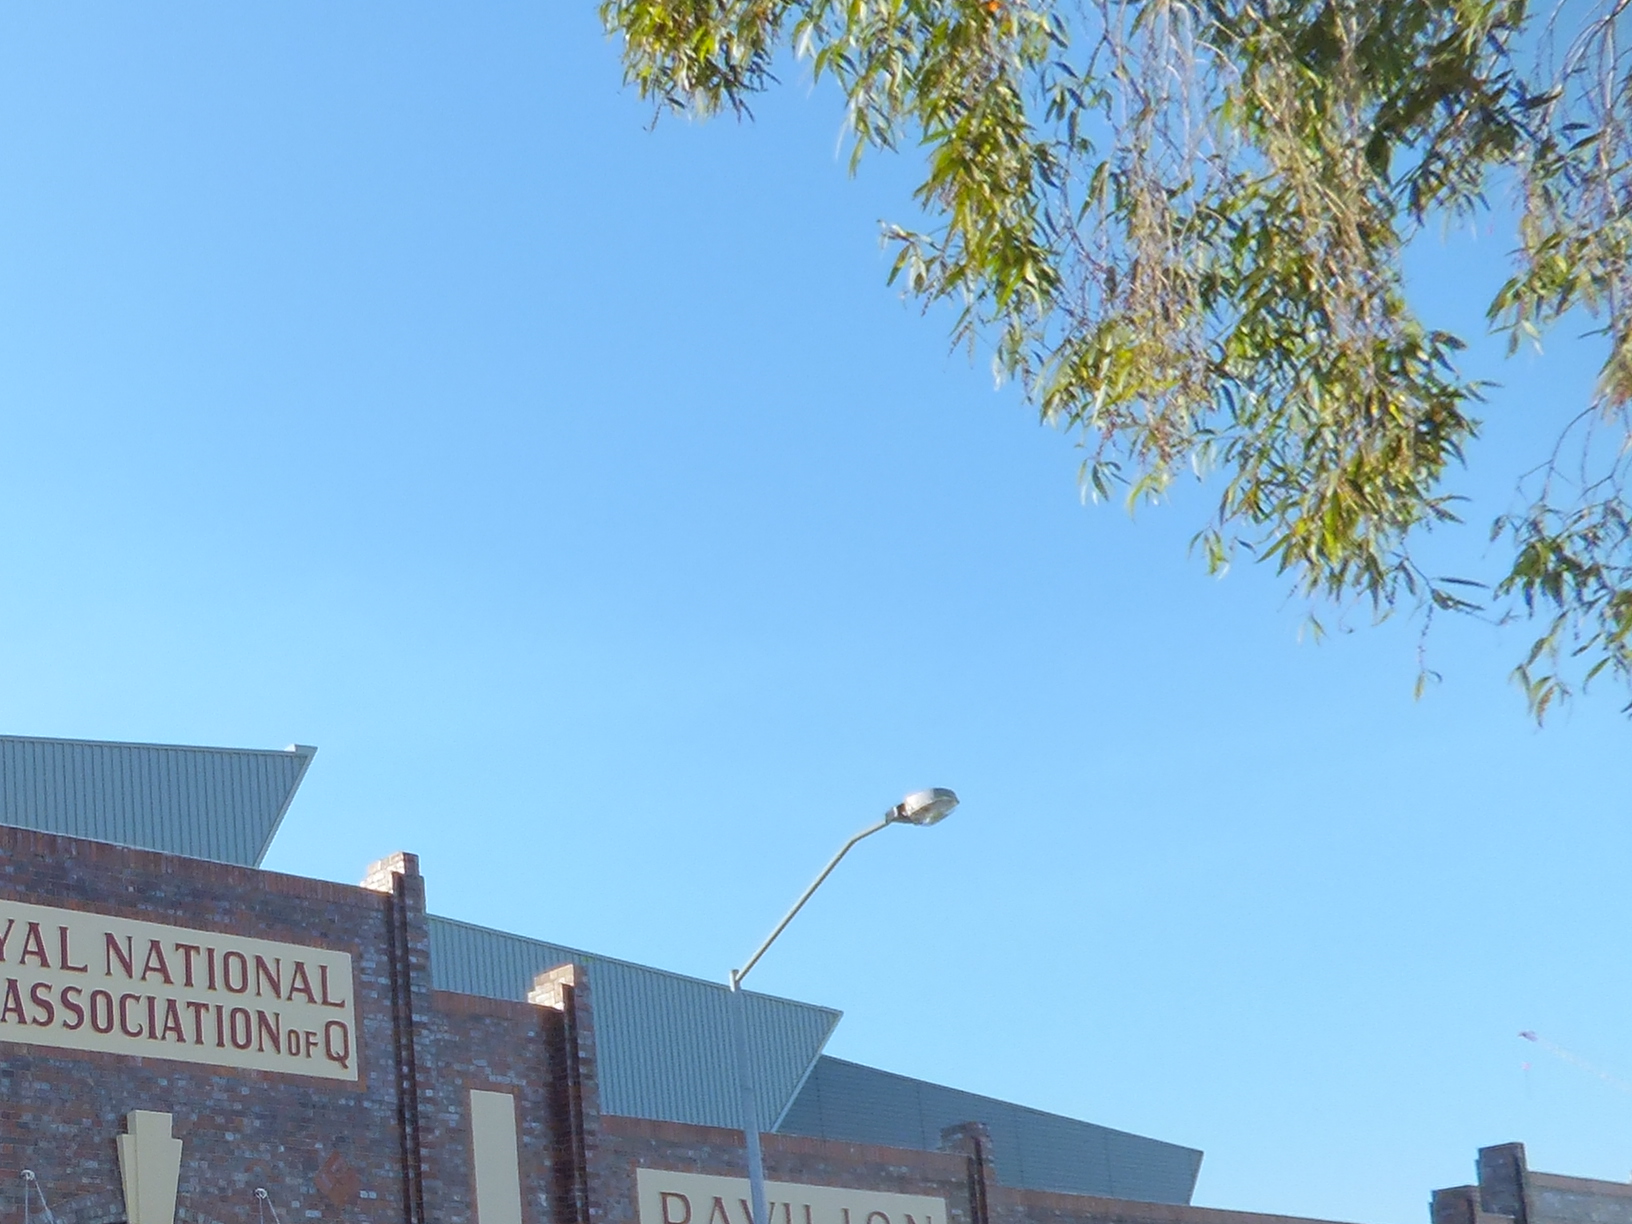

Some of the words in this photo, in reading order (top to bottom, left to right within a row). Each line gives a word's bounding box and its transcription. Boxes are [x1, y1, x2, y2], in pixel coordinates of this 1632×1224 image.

[104, 931, 346, 1008] NATIONAL
[0, 977, 282, 1054] ASSOCIATION
[323, 1019, 351, 1070] Q
